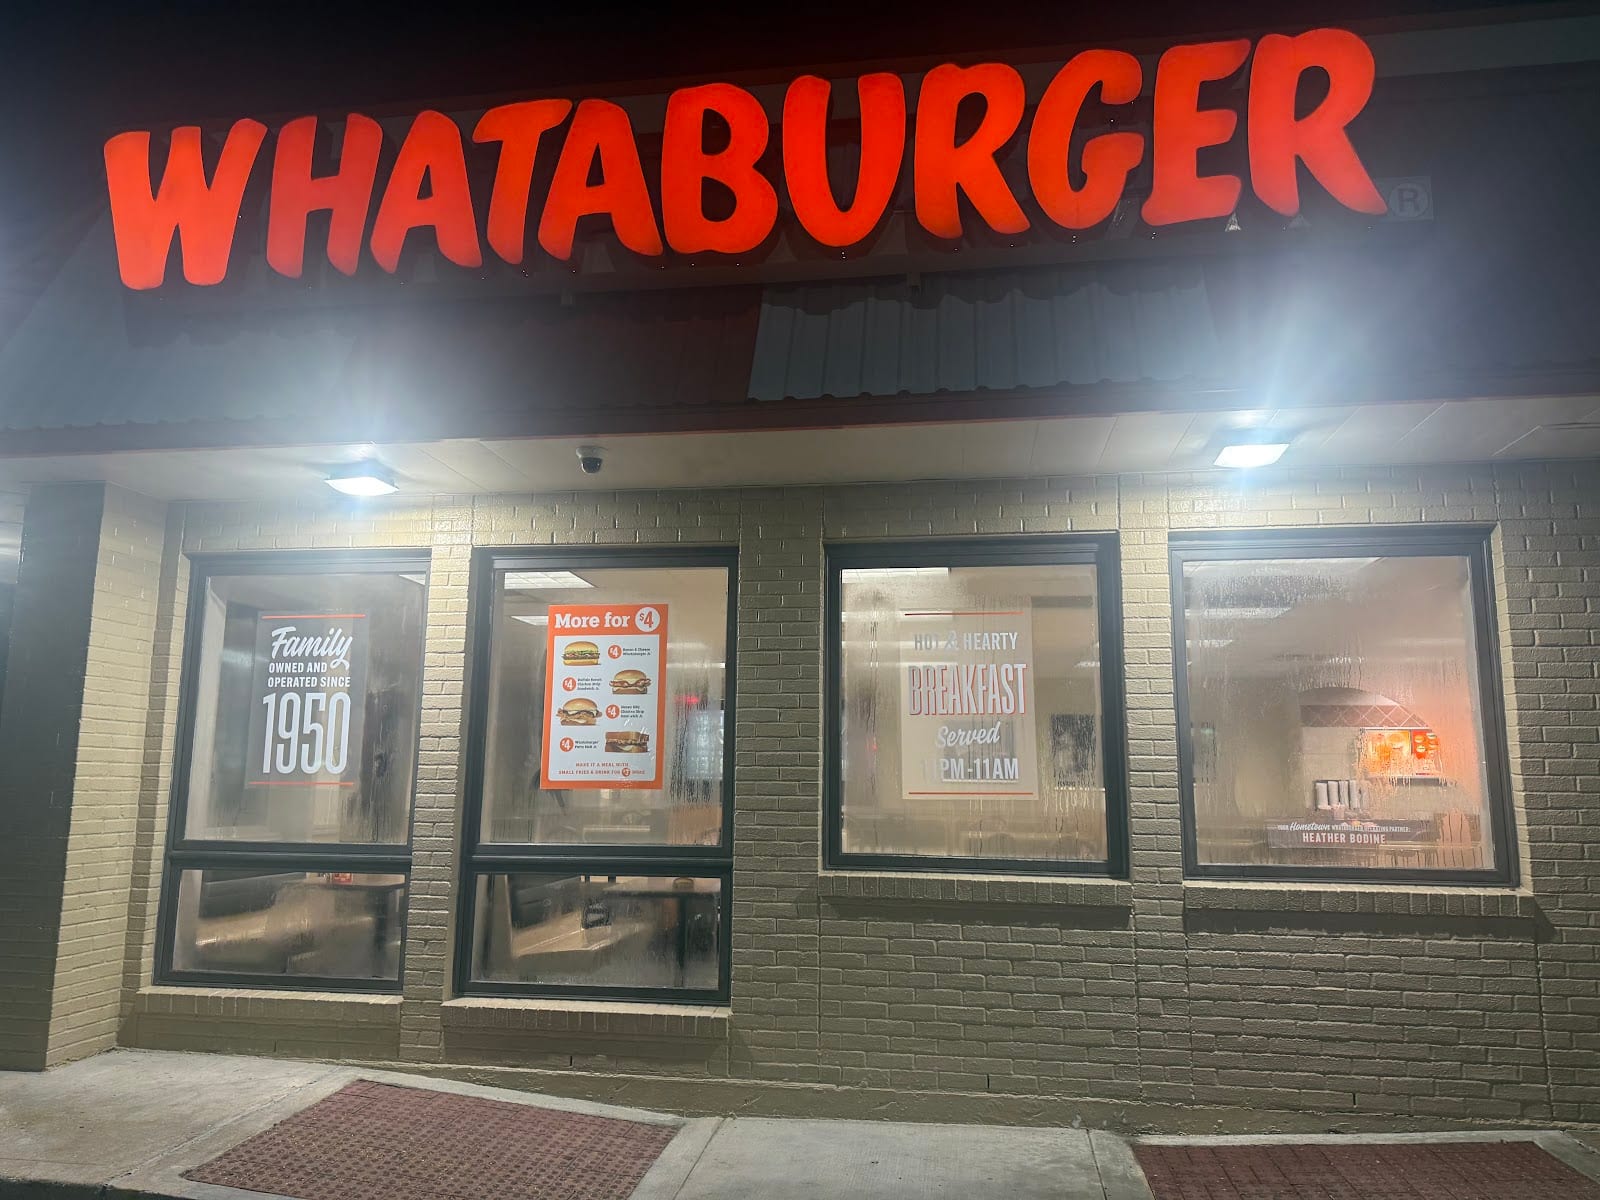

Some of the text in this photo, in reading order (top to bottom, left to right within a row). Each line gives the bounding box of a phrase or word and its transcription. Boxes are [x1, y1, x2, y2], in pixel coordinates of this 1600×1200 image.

[104, 28, 1387, 290] WHATABURGER
[554, 611, 654, 629] More for $4
[271, 626, 353, 671] Family
[963, 632, 1018, 650] HEARTY
[269, 662, 328, 673] OWNED AND
[267, 676, 351, 688] OPERATED SINCE
[908, 663, 1027, 716] BREAKFAST
[262, 691, 351, 775] 1950
[935, 720, 1001, 748] Served
[1289, 821, 1331, 831] Hometown
[1302, 832, 1386, 844] HEATHER BODINE
